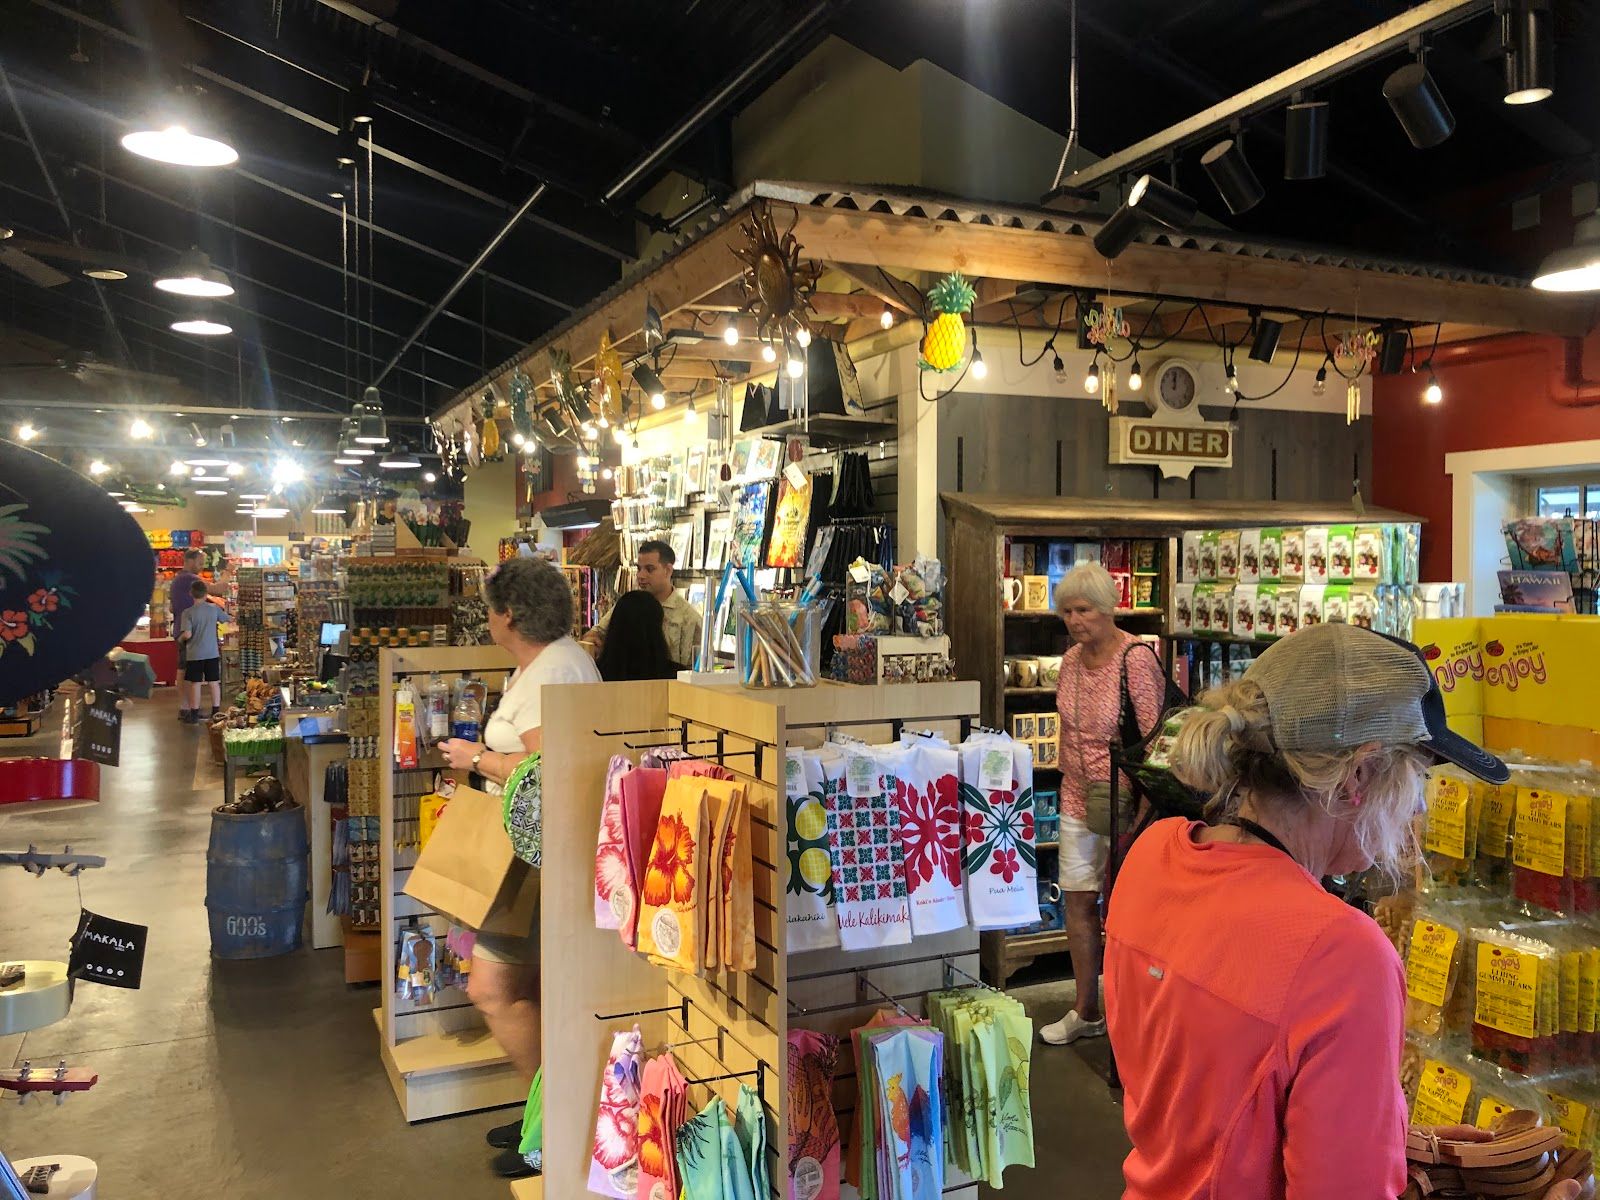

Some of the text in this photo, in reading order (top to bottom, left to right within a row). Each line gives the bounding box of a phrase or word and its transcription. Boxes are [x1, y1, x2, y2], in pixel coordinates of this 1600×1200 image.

[1134, 430, 1223, 453] DINER
[1510, 575, 1560, 585] HAWAII
[1434, 651, 1485, 692] njoy
[1486, 652, 1547, 692] enjoy
[84, 930, 135, 951] MAKALA
